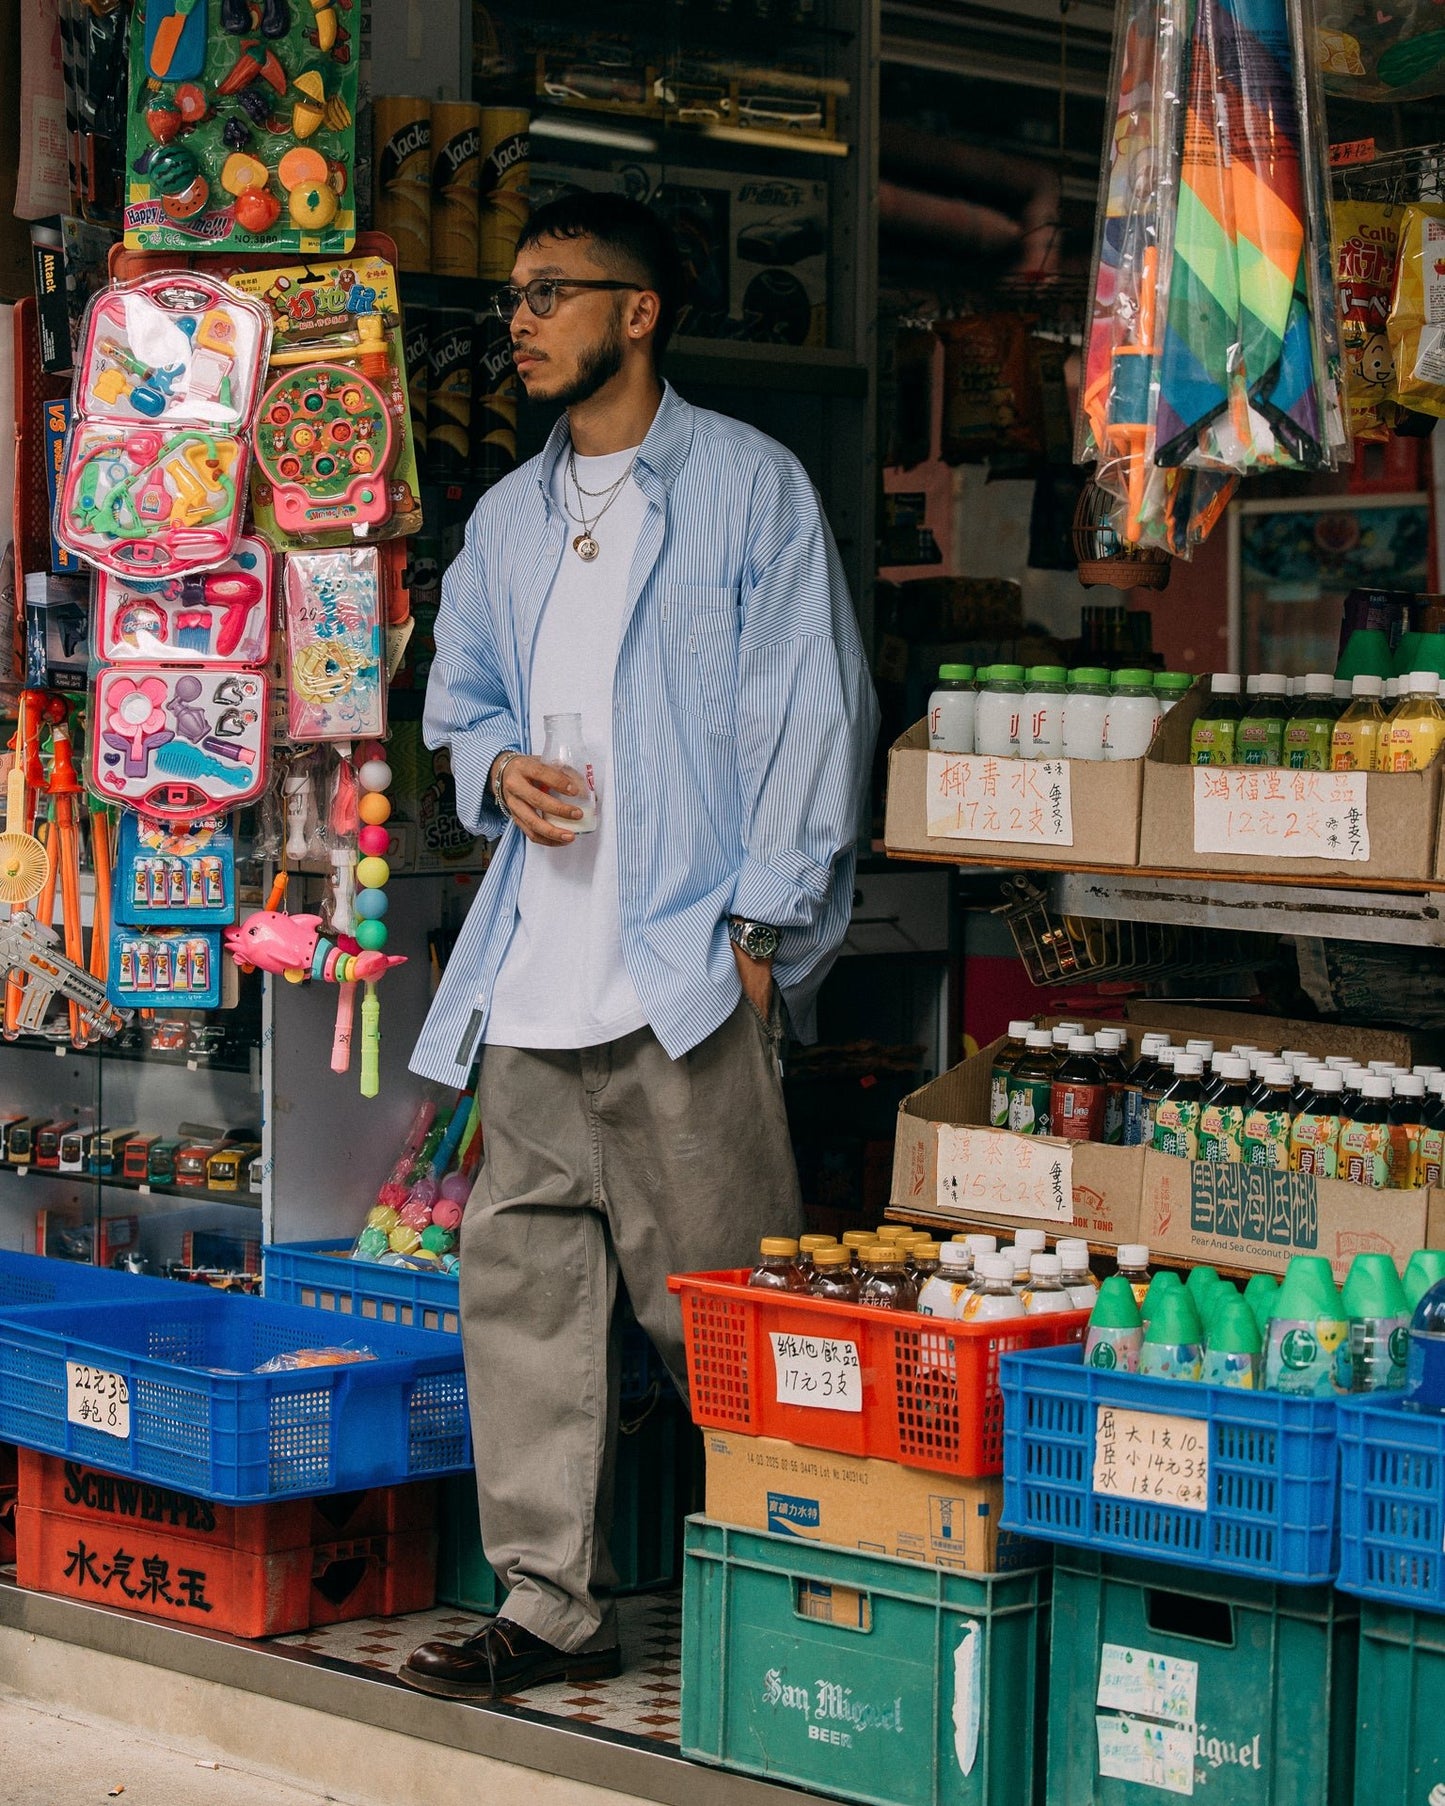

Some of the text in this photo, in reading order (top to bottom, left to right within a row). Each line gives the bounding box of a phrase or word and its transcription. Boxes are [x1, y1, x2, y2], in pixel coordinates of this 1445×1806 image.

[44, 254, 57, 294] Attack
[49, 404, 66, 433] VS
[1032, 710, 1047, 738] if
[940, 758, 1047, 801] 椰青水
[1347, 1157, 1364, 1185] 夏
[1093, 1219, 1113, 1232] TONG
[1190, 1235, 1209, 1247] Pear
[1210, 1239, 1228, 1250] And
[1229, 1241, 1244, 1253] Sea
[1246, 1244, 1282, 1259] Coconut
[64, 1461, 217, 1532] SCHWEPPES
[769, 1500, 818, 1520] 寶礦力水特
[762, 1668, 810, 1721] San
[808, 1725, 853, 1749] BEER
